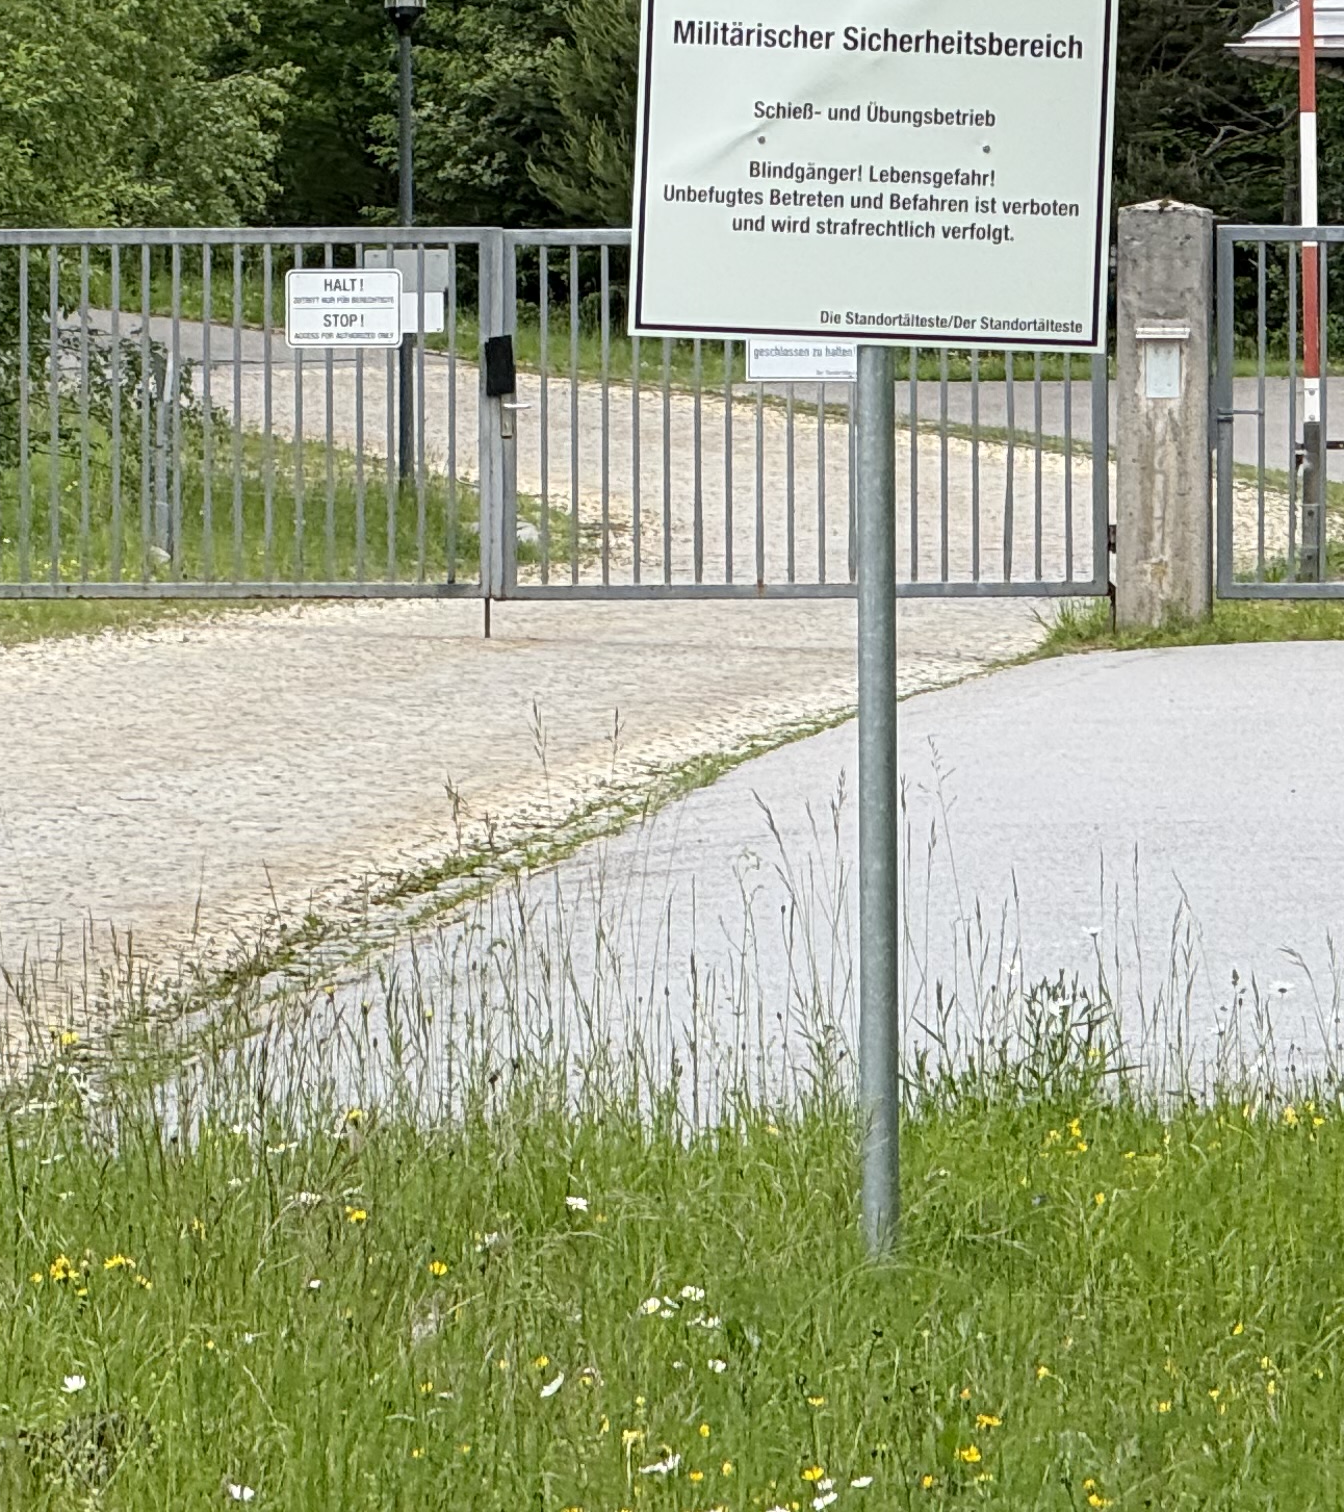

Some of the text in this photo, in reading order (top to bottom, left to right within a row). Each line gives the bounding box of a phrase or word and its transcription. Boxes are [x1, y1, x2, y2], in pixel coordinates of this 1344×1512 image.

[674, 20, 1083, 59] Militärischer Sicherheitsbereich
[754, 101, 995, 127] Schieß- und Übungsbetrieb
[749, 161, 995, 187] Blindgänger! Lebensgefahr!
[664, 185, 1079, 216] Unbefugtes Betreten und Befahren ist verboten
[733, 217, 1014, 244] und wird strafrechtlich verfolgt.
[820, 311, 1083, 333] Die Standortälteste/Der Standortälteste
[754, 346, 809, 359] geschlossen
